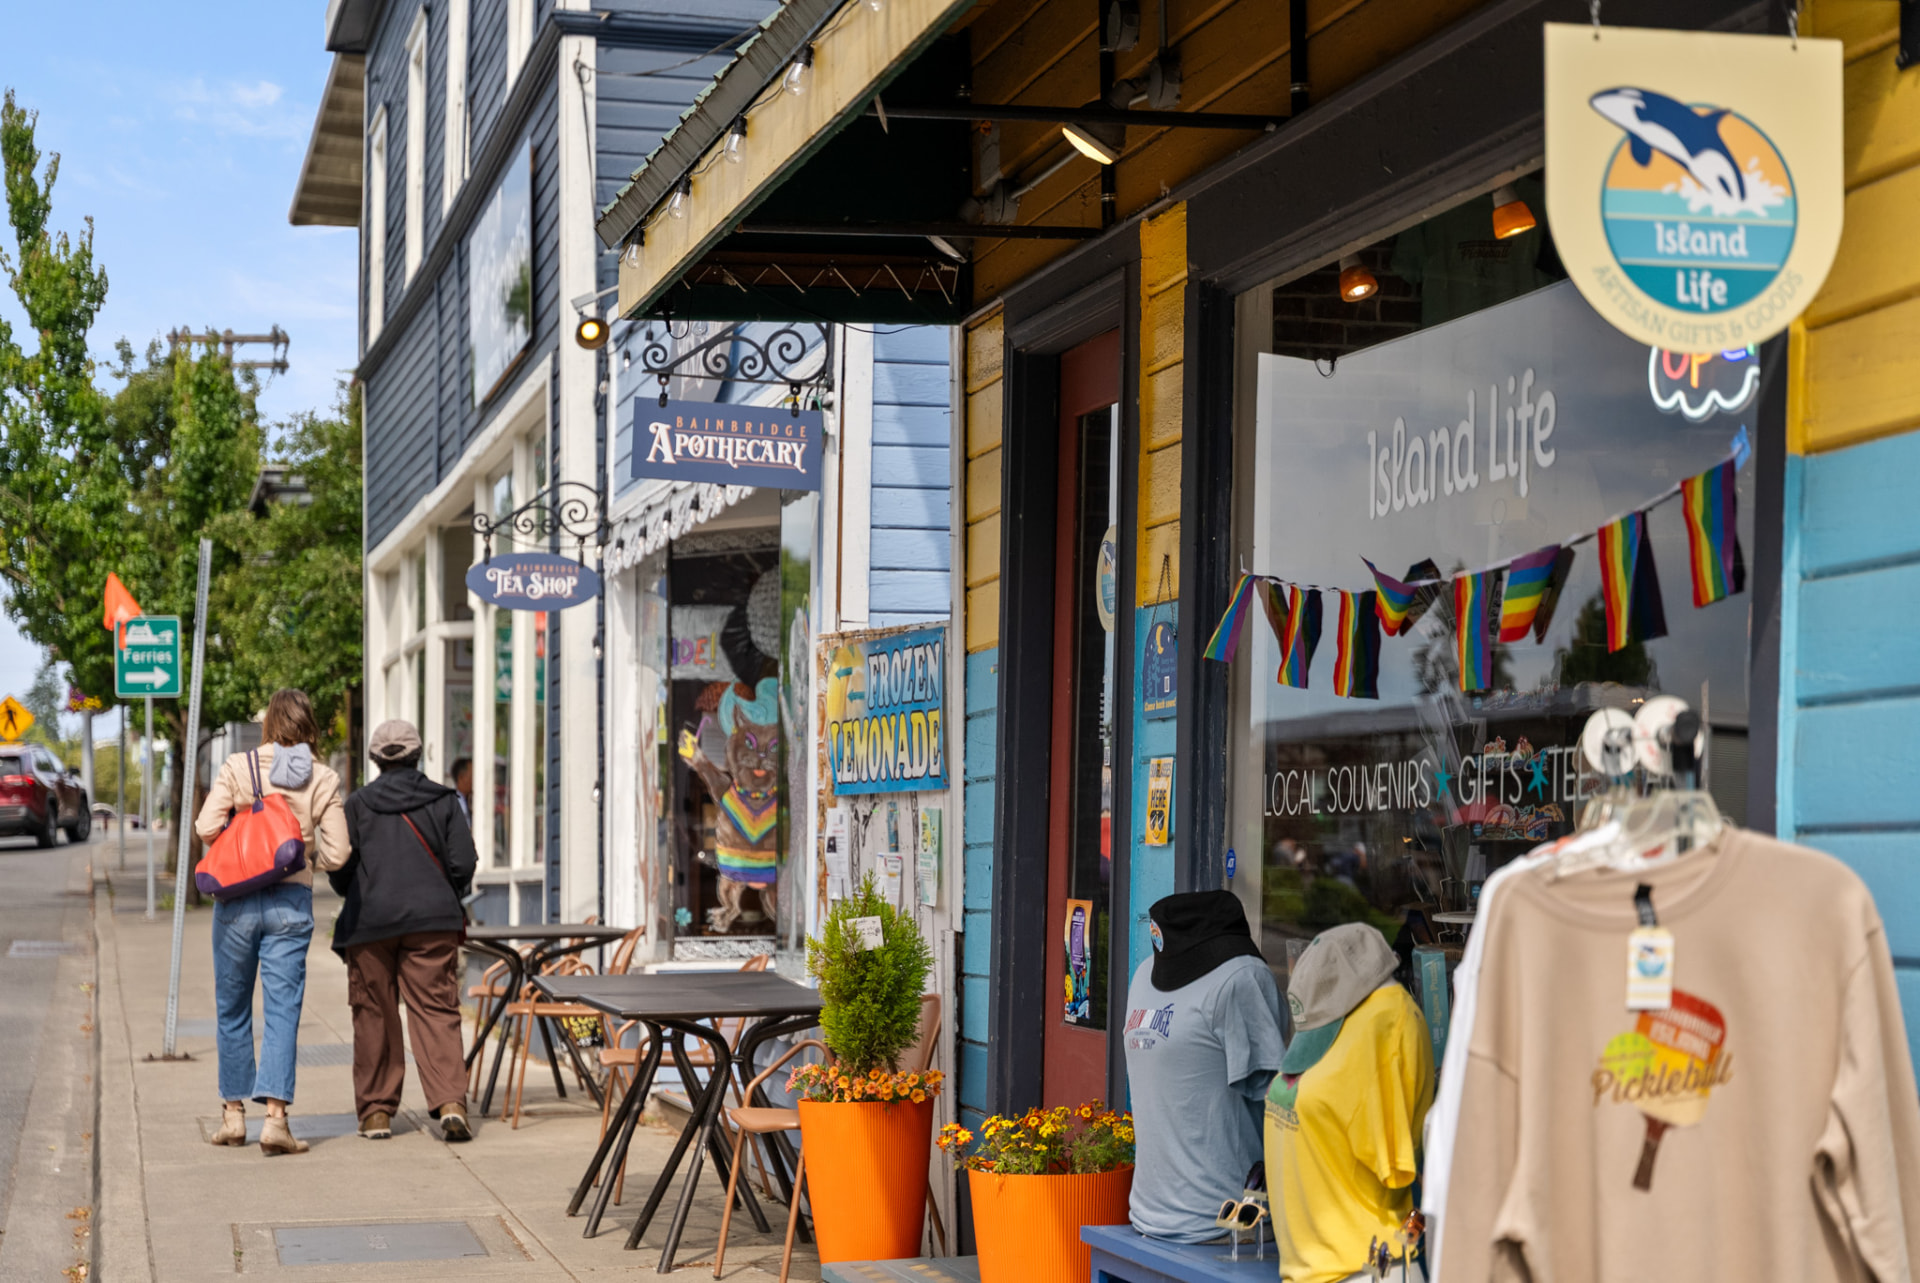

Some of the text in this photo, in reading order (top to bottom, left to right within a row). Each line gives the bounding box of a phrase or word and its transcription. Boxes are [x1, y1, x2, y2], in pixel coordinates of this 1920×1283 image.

[1655, 222, 1748, 257] Island
[1592, 264, 1804, 346] ARTISAN GIFTS & GOODS
[1675, 268, 1728, 310] Life
[646, 421, 808, 475] APOTHECARY
[676, 416, 807, 438] BAINBRIDGE
[1367, 367, 1556, 520] Island Life
[485, 567, 578, 600] TEA SHOP
[516, 563, 579, 574] BAINBRIDGE
[123, 648, 172, 664] Ferries
[867, 640, 941, 710] FROZEN
[829, 707, 942, 784] LEMONADE
[1150, 789, 1167, 808] HERE
[1264, 769, 1321, 816] LOCAL
[1327, 758, 1431, 813] SOUVENIRS
[1458, 751, 1522, 805] GIFTS
